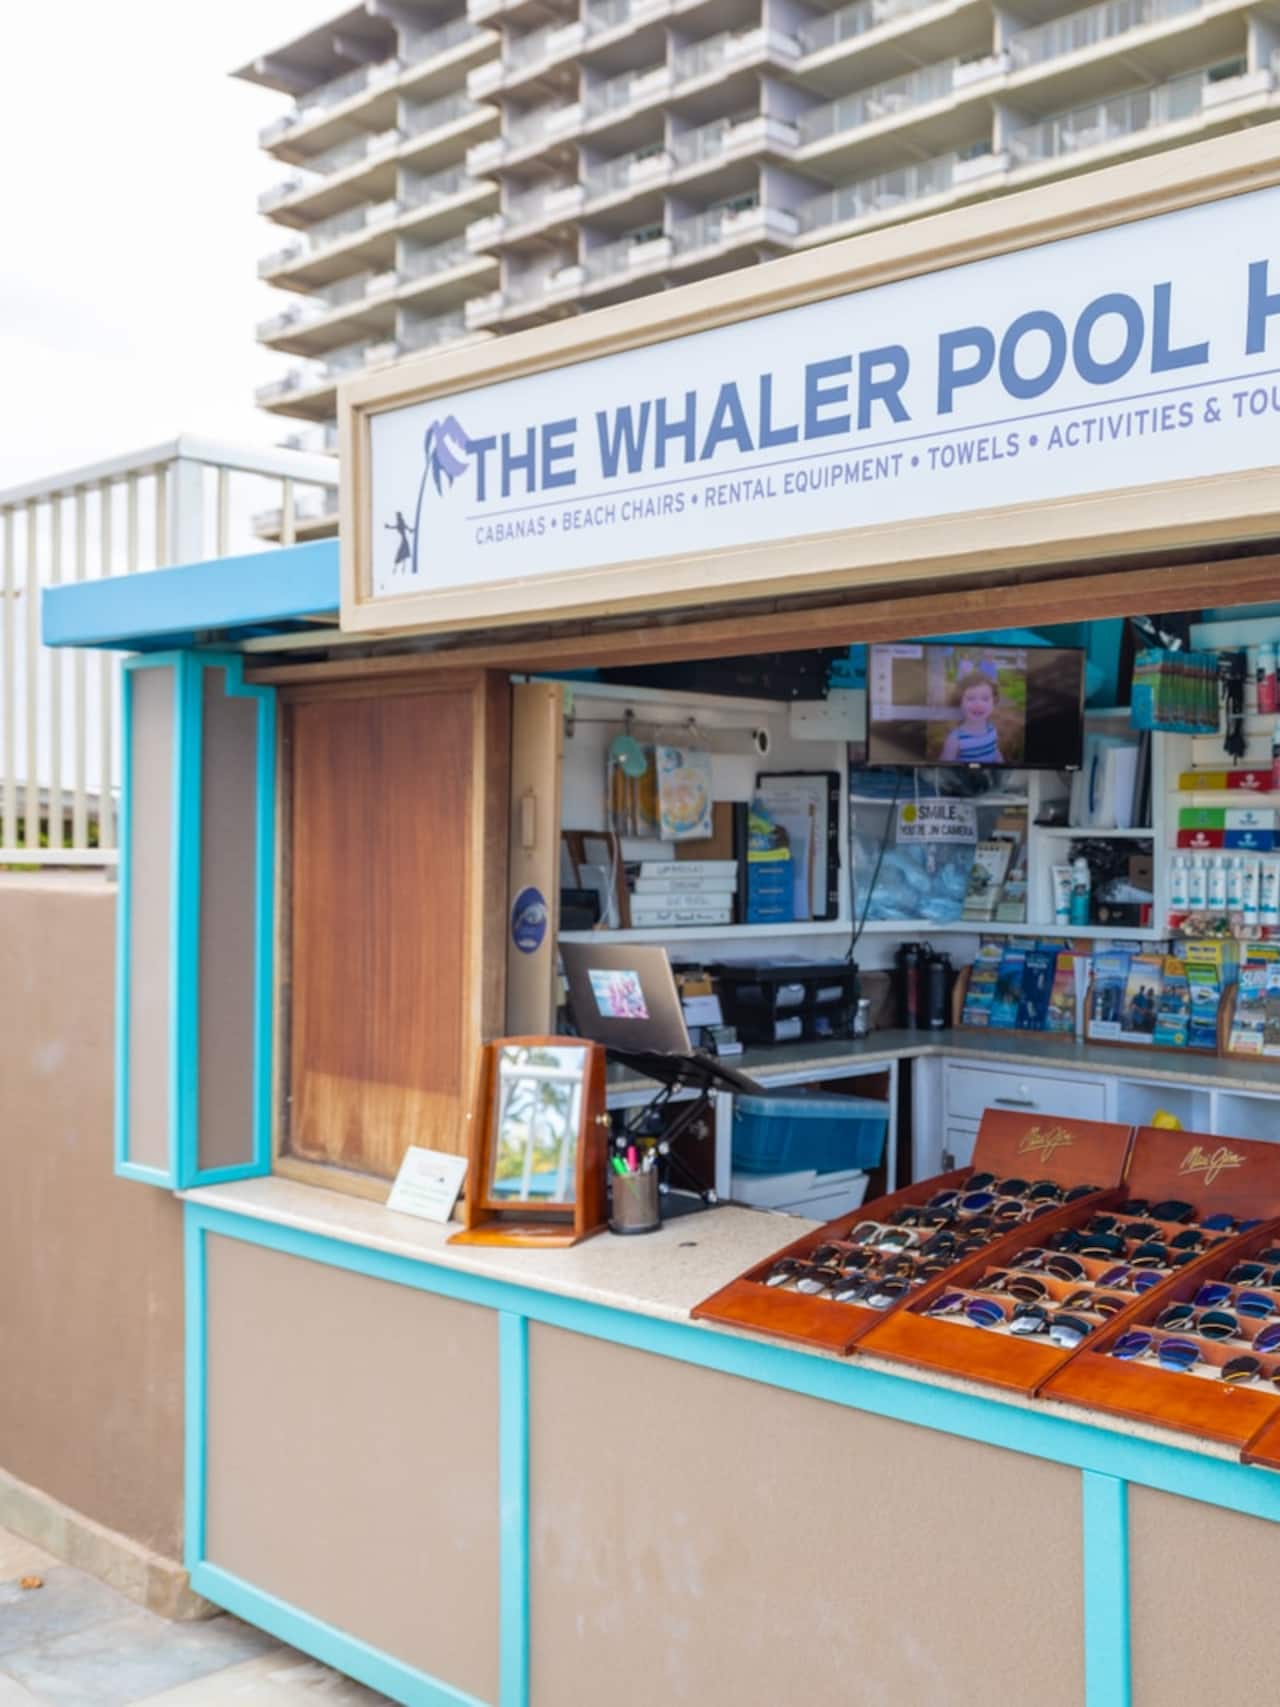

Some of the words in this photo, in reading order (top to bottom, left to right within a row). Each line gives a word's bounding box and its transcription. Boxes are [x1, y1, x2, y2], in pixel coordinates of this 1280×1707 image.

[467, 417, 577, 503] THE
[595, 344, 912, 480] WHALER
[935, 280, 1211, 416] POOL
[475, 516, 546, 546] CABANAS
[562, 505, 617, 533] BEACH
[621, 491, 685, 521] CHAIRS
[704, 478, 777, 508] RENTAL
[784, 453, 903, 495] EQUIPMENT
[928, 432, 1020, 471] TOWELS
[1047, 400, 1194, 450] ACTIVITIES
[1203, 396, 1222, 426] &
